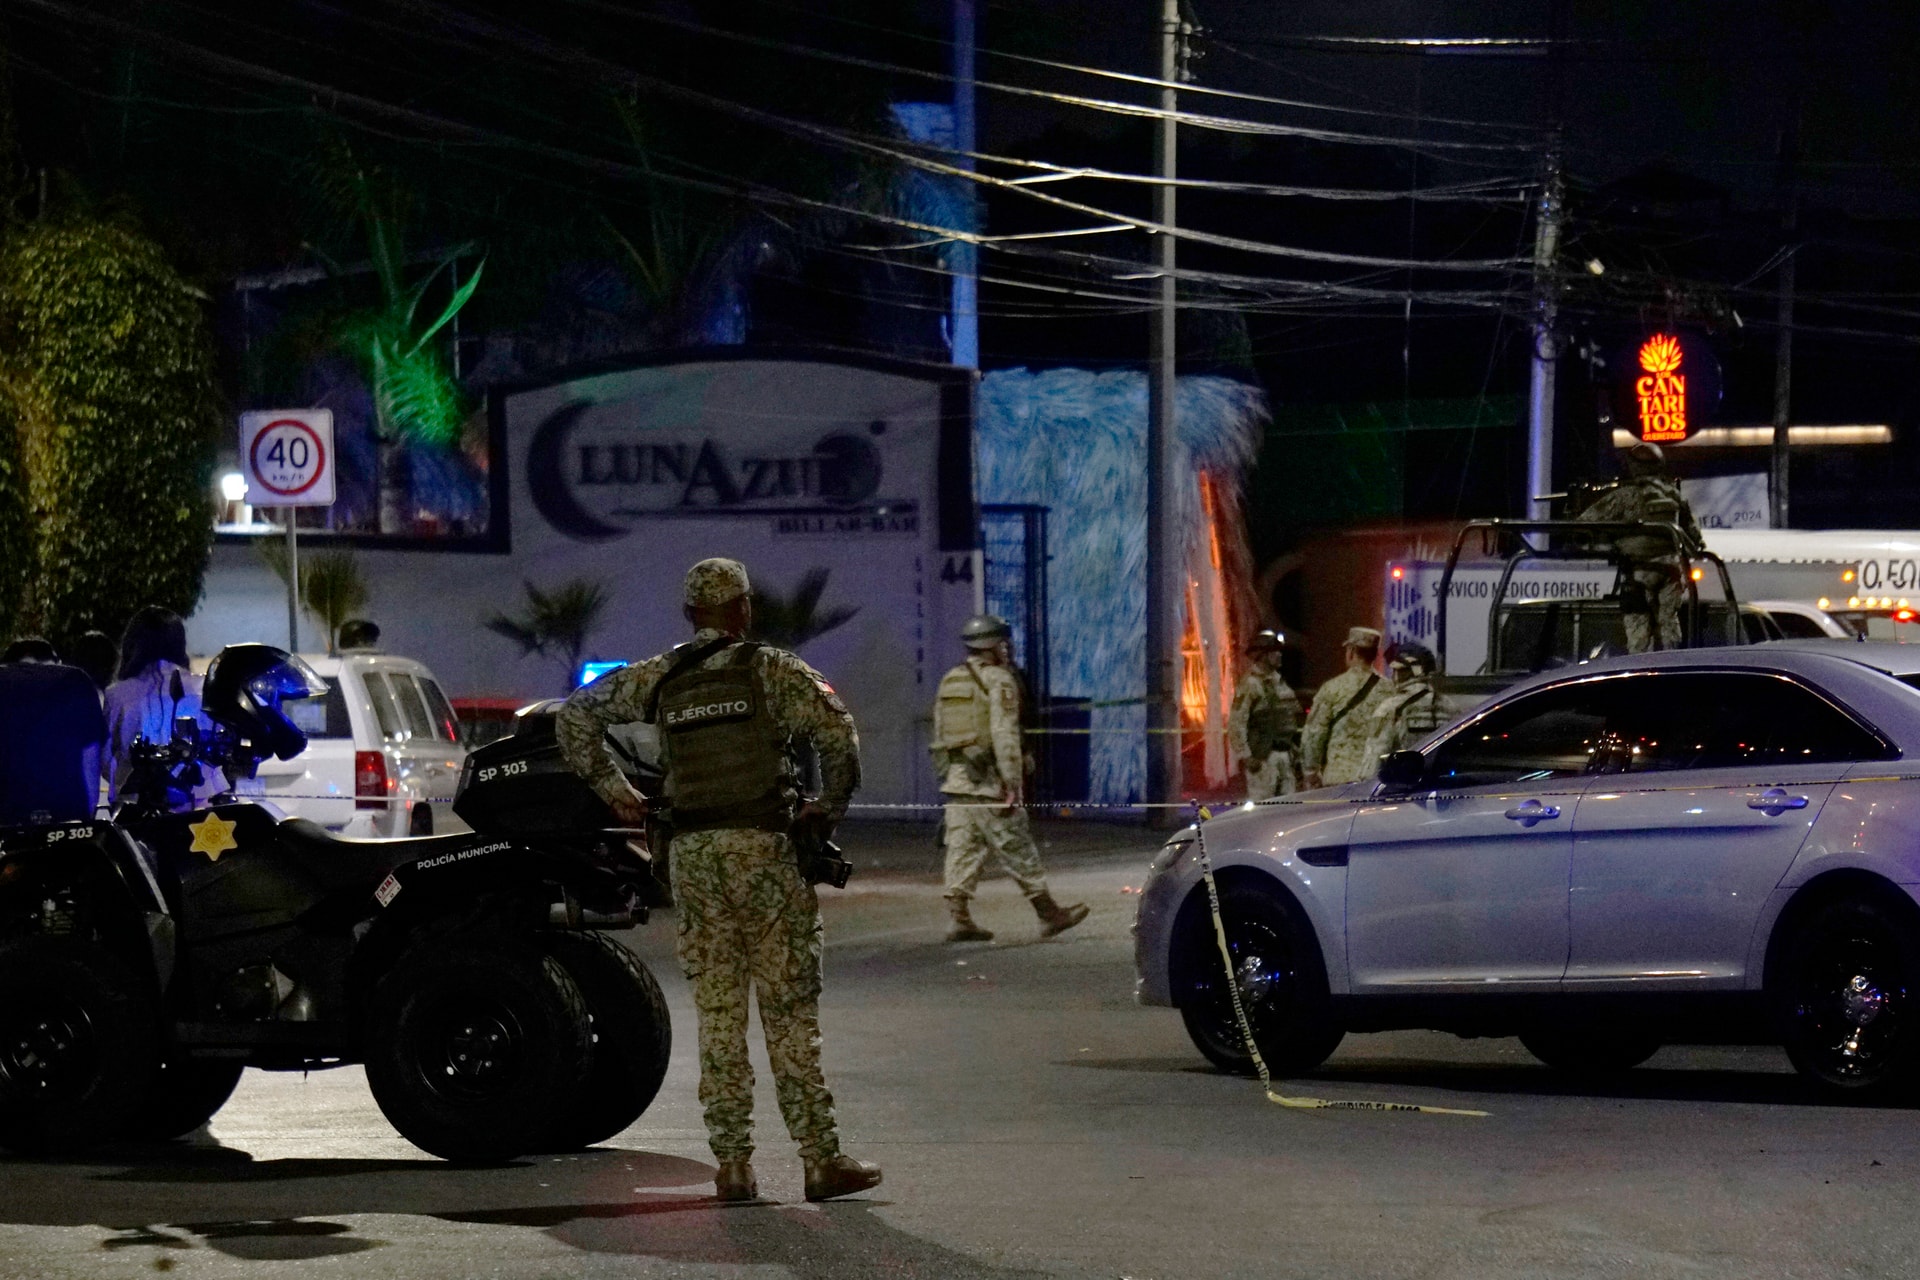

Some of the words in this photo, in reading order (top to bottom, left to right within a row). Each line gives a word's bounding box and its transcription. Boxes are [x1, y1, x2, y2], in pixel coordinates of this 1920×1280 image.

[1637, 375, 1685, 396] CAN
[1638, 394, 1685, 414] TARI
[1639, 412, 1687, 433] TOS
[266, 437, 309, 469] 40
[1734, 510, 1762, 523] 2024
[1432, 581, 1488, 598] SRVICIO
[1492, 581, 1540, 598] MDICO
[1543, 581, 1600, 599] FORENSE
[666, 700, 748, 724] EJÉRCITO
[478, 767, 498, 782] SP
[501, 760, 528, 777] 303
[46, 830, 66, 843] SP
[68, 826, 94, 840] 303
[416, 853, 456, 871] POLICÍA
[457, 841, 512, 861] MUNICIPAL
